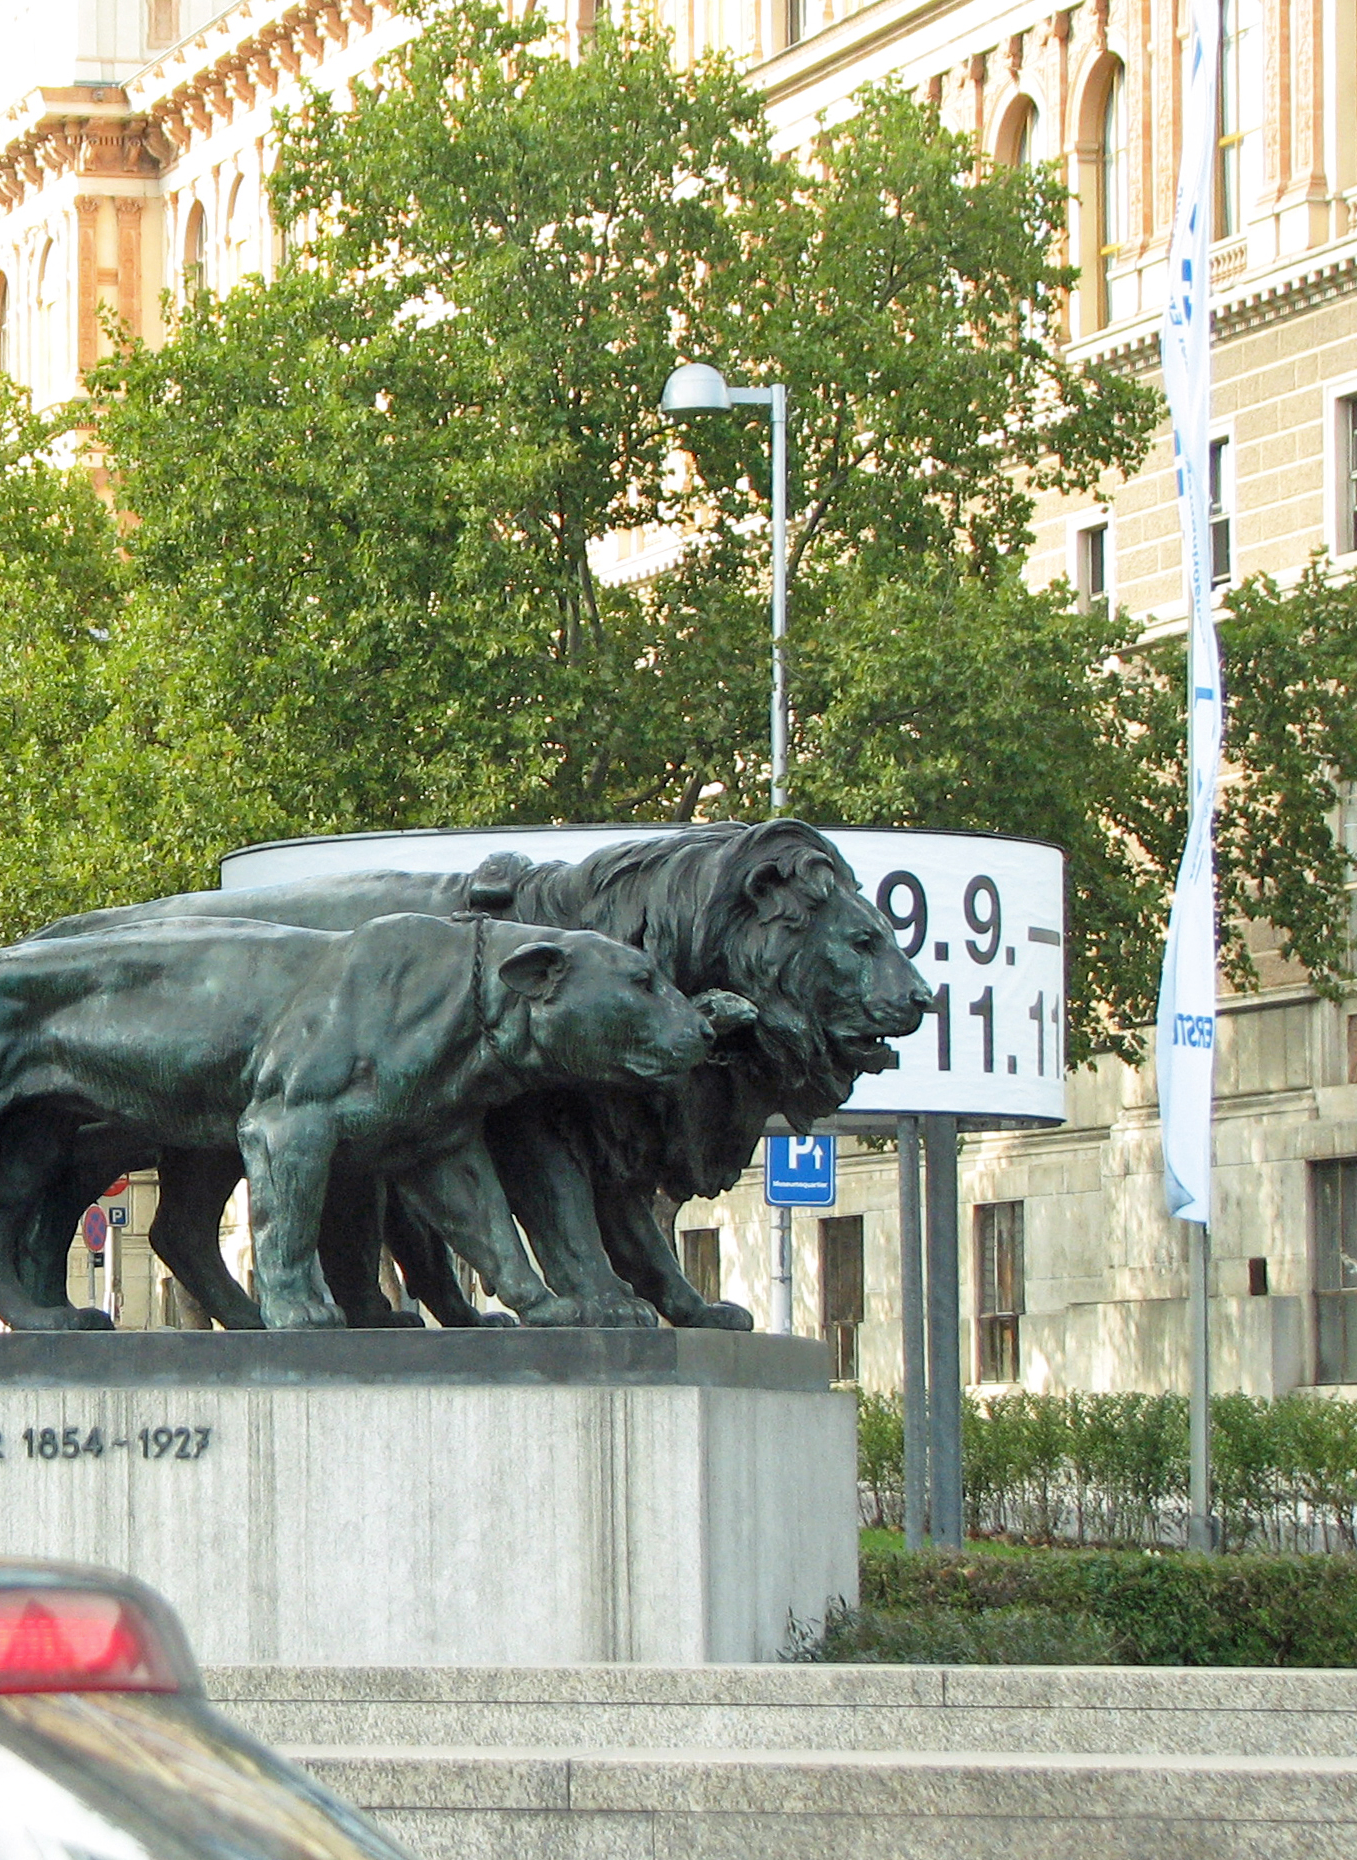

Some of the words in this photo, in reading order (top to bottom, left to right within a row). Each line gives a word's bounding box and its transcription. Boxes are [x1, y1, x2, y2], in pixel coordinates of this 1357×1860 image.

[112, 1209, 123, 1223] P
[23, 1427, 103, 1459] 1854
[140, 1427, 213, 1459] 1927
